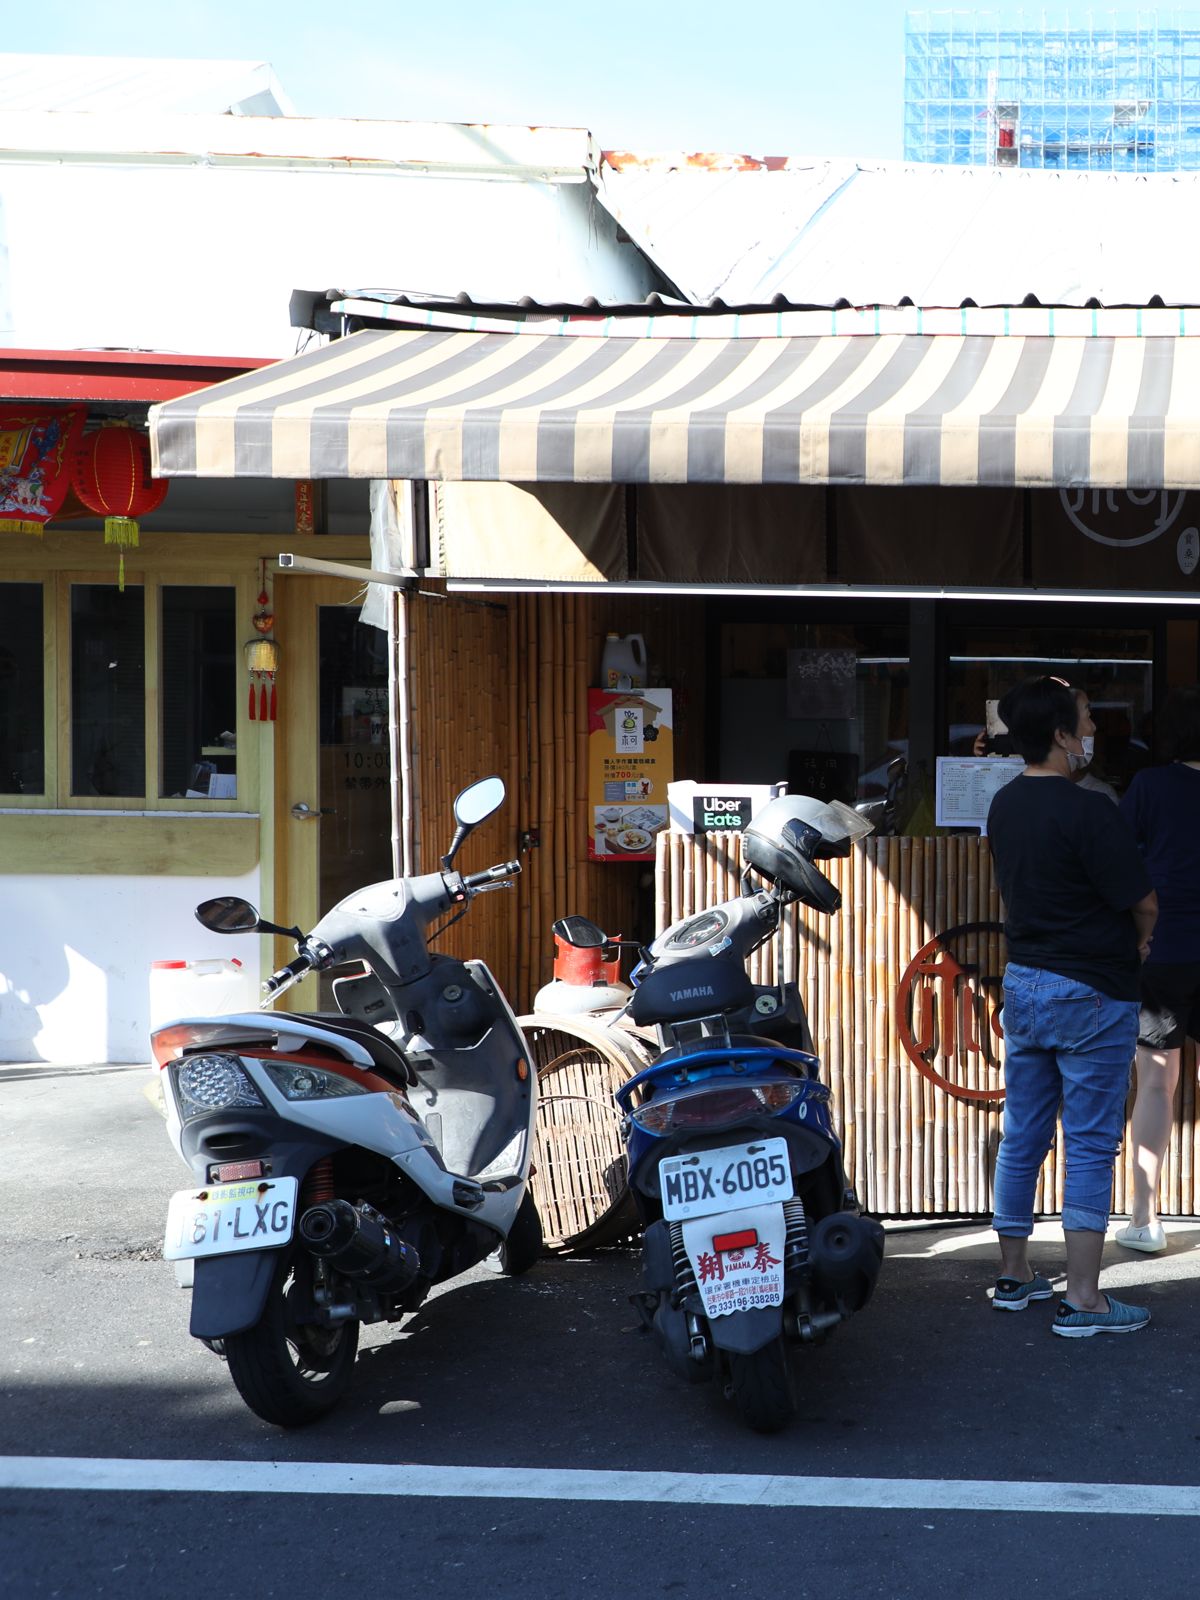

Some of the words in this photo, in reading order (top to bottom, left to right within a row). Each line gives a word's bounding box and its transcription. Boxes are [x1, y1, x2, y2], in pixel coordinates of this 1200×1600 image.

[703, 797, 741, 811] Uber
[703, 812, 742, 826] Eats
[669, 985, 714, 1002] YAMAHA
[725, 1261, 752, 1273] YAMAHA
